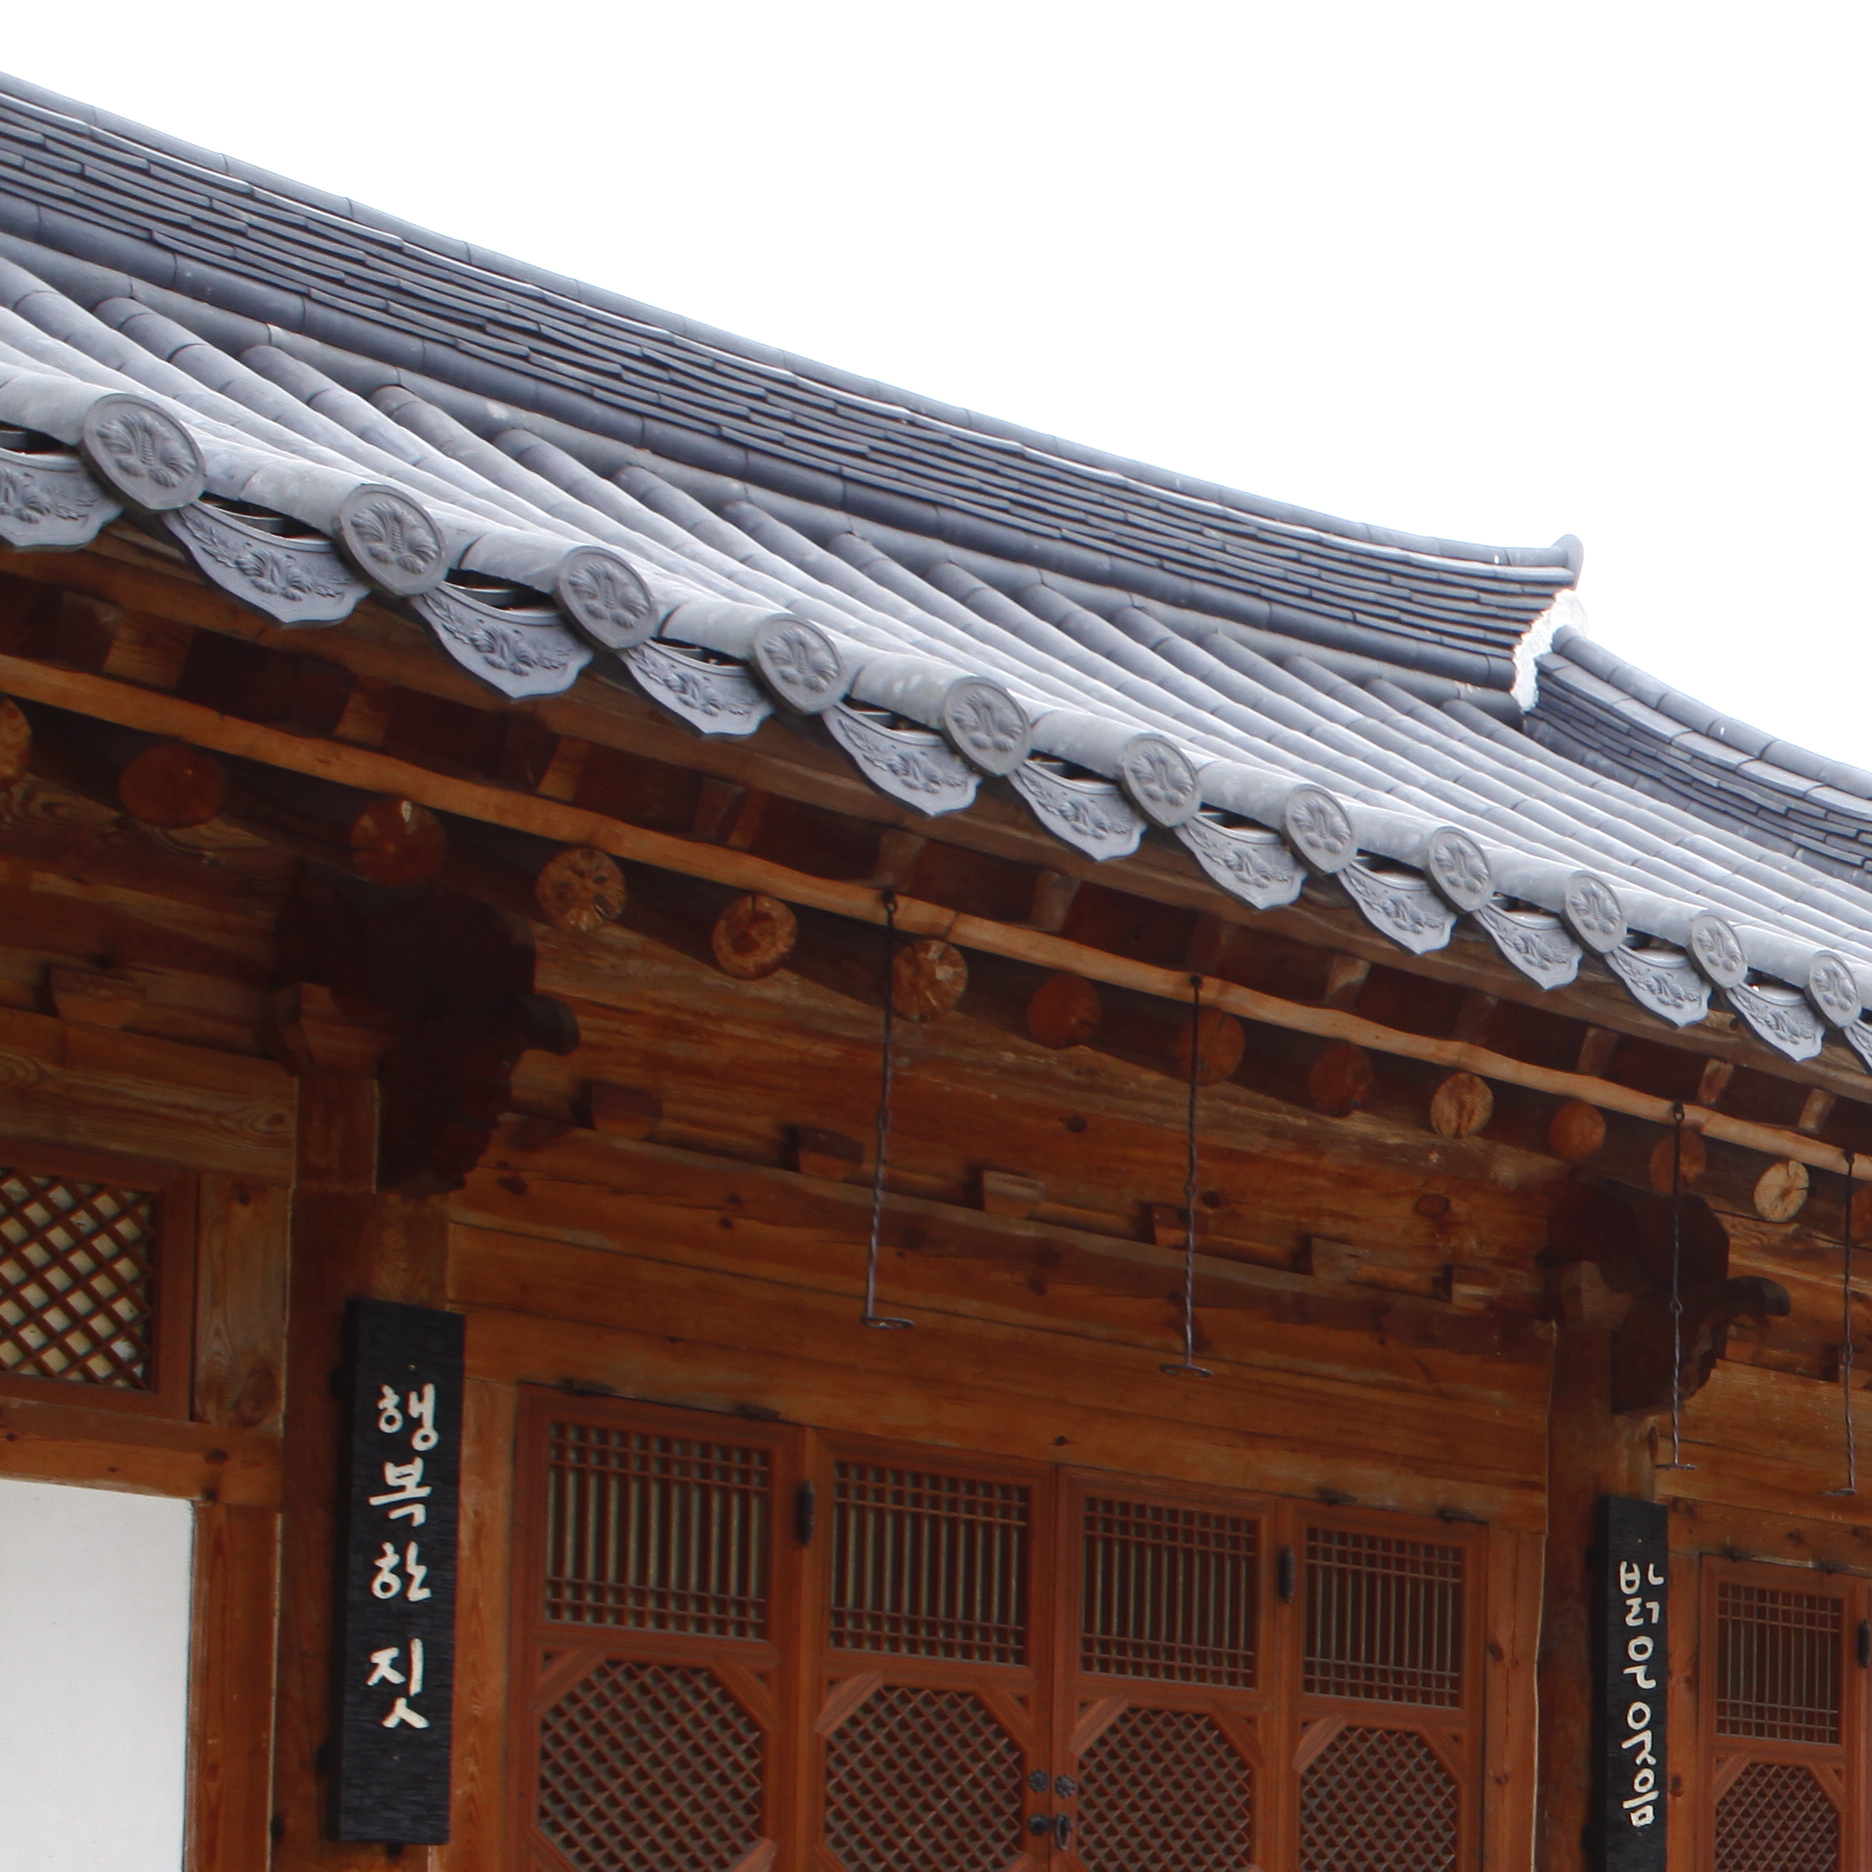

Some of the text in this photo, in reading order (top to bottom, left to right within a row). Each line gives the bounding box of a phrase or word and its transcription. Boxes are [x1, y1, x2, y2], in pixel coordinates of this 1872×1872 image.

[366, 1382, 439, 1730] 행복한 짓
[1617, 1560, 1666, 1830] 밝은 웃음
